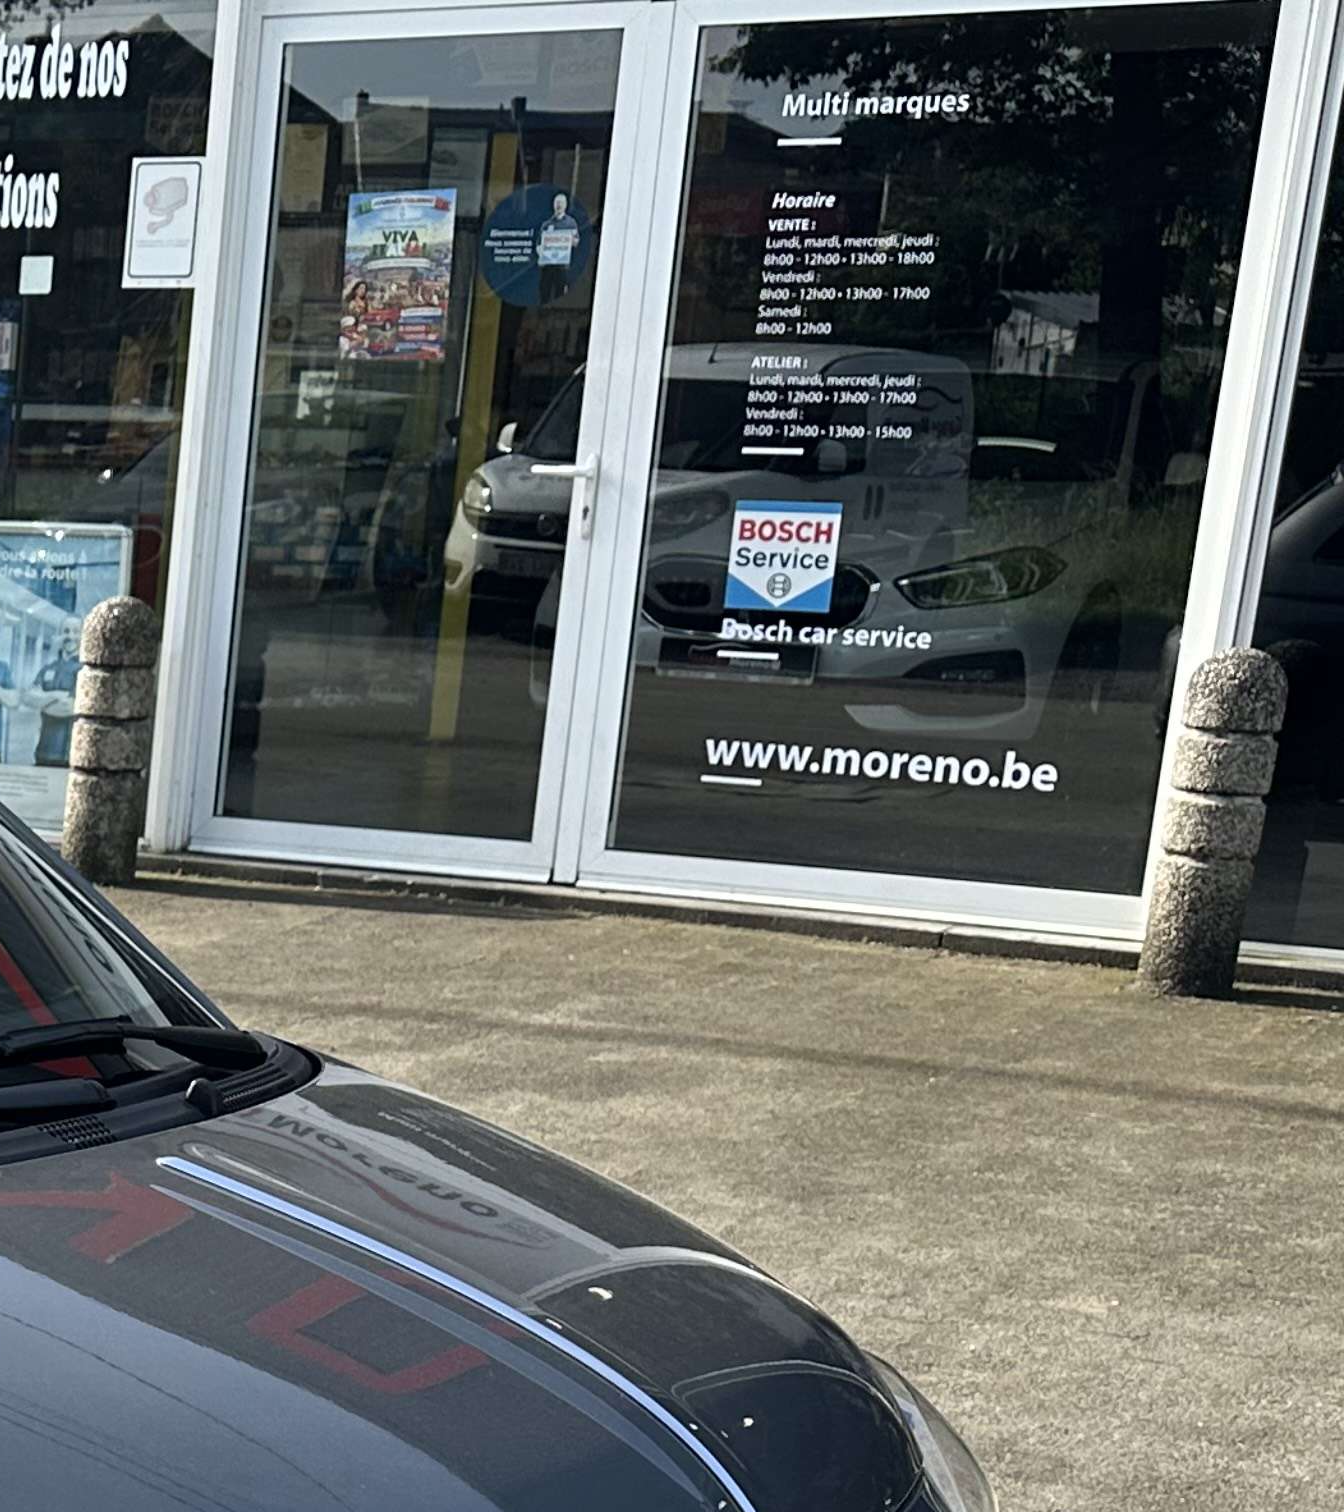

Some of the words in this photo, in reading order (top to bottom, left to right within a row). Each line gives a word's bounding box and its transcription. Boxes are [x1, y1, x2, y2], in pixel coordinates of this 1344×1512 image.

[39, 23, 73, 99] de
[77, 39, 129, 98] nos
[781, 93, 852, 117] Multi
[855, 92, 970, 119] marques
[772, 192, 836, 208] Horaire
[383, 230, 419, 243] VIVA
[765, 236, 801, 249] Lundi,
[804, 236, 841, 248] mardi,
[844, 234, 899, 248] mercredi,
[764, 253, 793, 266] 8h00
[804, 253, 840, 265] 12h00
[850, 252, 886, 265] 13h00
[897, 252, 934, 265] 18h00
[760, 288, 789, 300] 8h00
[800, 288, 835, 300] 12h00
[846, 288, 882, 300] 13h00
[893, 287, 930, 299] 17h00
[756, 323, 785, 334] 8h00
[796, 322, 832, 334] 12h00
[749, 373, 785, 386] Lundi,
[787, 374, 824, 387] mardi,
[826, 374, 881, 388] mercredi,
[747, 391, 776, 403] 8h00
[787, 391, 823, 403] 12h00
[833, 391, 869, 404] 13h00
[880, 392, 917, 404] 17h00
[743, 425, 773, 437] 8h00
[783, 425, 819, 437] 12h00
[829, 425, 865, 438] 13h00
[876, 426, 912, 438] 15h00
[737, 519, 834, 543] BOSCH
[735, 547, 830, 570] Service
[719, 618, 792, 643] Bosch
[799, 625, 837, 645] car
[842, 626, 932, 650] service
[705, 738, 1059, 792] www.moreno.be
